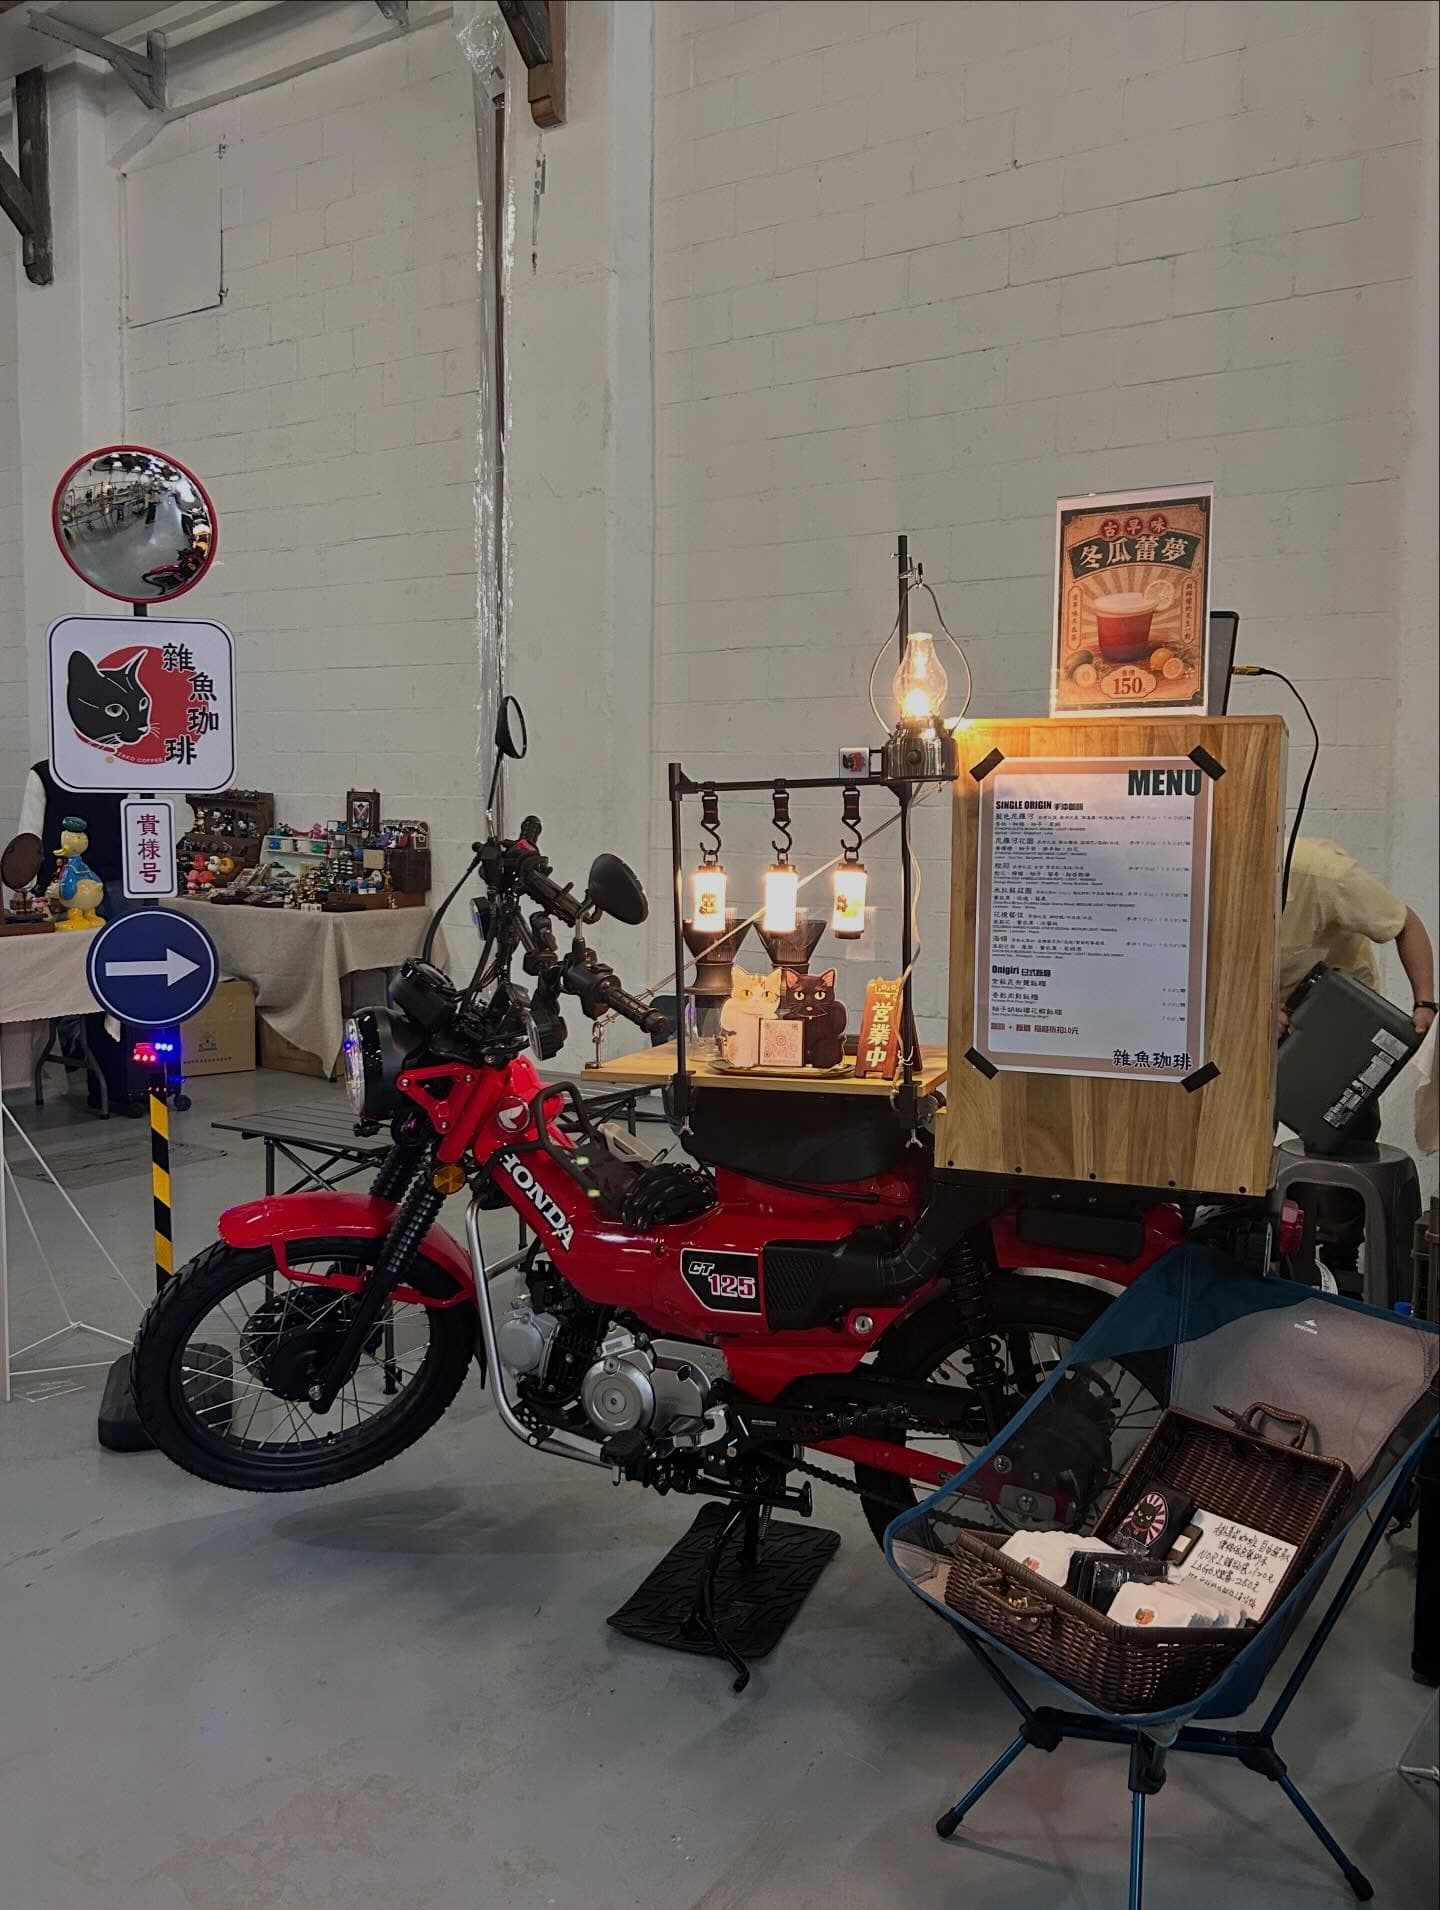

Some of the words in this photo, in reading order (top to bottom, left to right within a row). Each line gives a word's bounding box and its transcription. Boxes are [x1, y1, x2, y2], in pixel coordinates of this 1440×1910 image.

[1103, 518, 1165, 538] 古早味
[1080, 536, 1188, 568] 冬瓜蕾夢
[1112, 677, 1143, 695] 150
[162, 642, 219, 765] 雜魚珈琲
[1128, 769, 1202, 796] MENU
[995, 801, 1023, 810] SINGLE
[1024, 801, 1052, 810] ORIGIN
[992, 965, 1020, 975] Onigiri
[1112, 1048, 1193, 1071] 雜魚珈琲
[500, 1152, 575, 1251] HONDA
[688, 1261, 716, 1276] CT
[708, 1273, 756, 1299] 125
